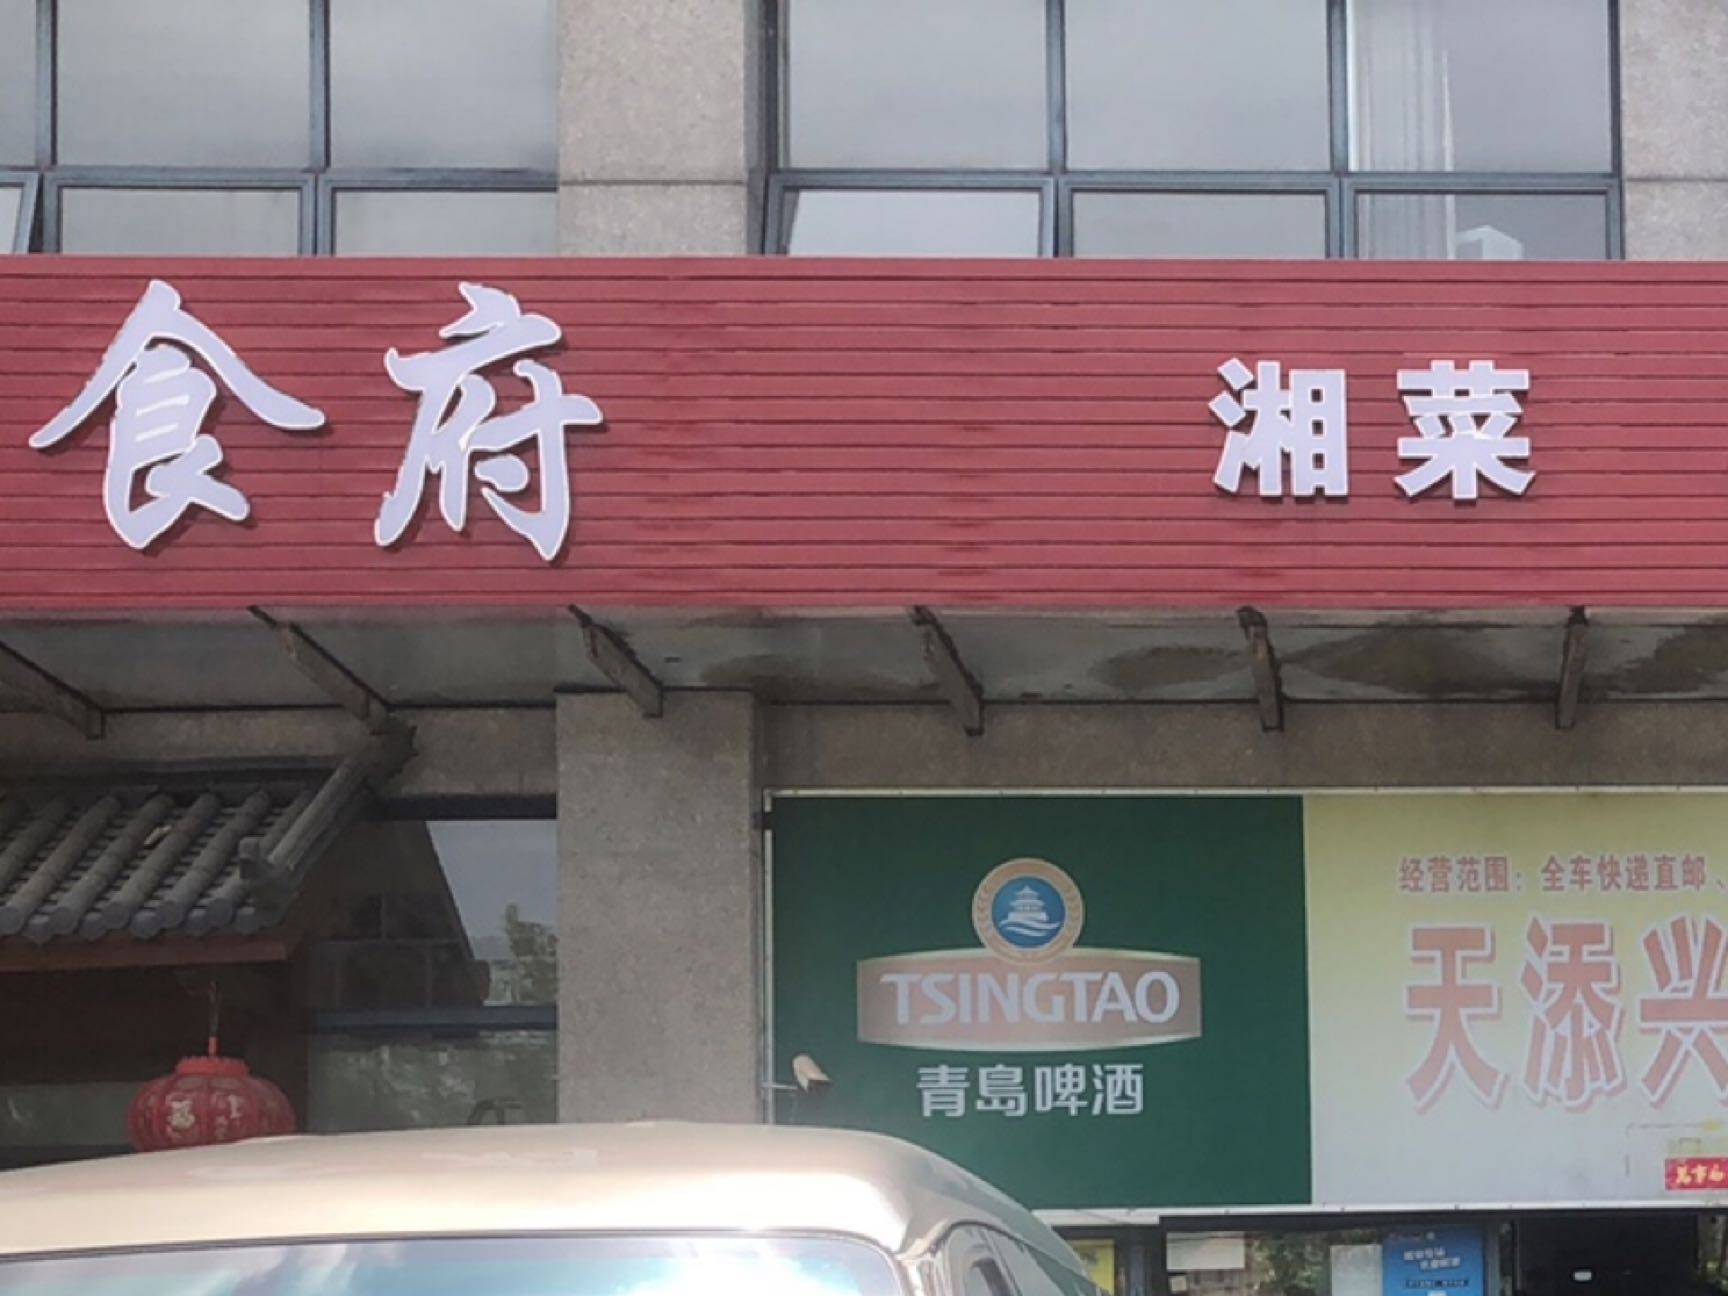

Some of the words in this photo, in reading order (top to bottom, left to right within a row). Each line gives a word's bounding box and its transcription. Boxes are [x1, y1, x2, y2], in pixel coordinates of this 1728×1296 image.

[28, 278, 604, 562] 食府
[1208, 357, 1537, 501] 湘菜
[880, 970, 1182, 1024] TSINGTAO
